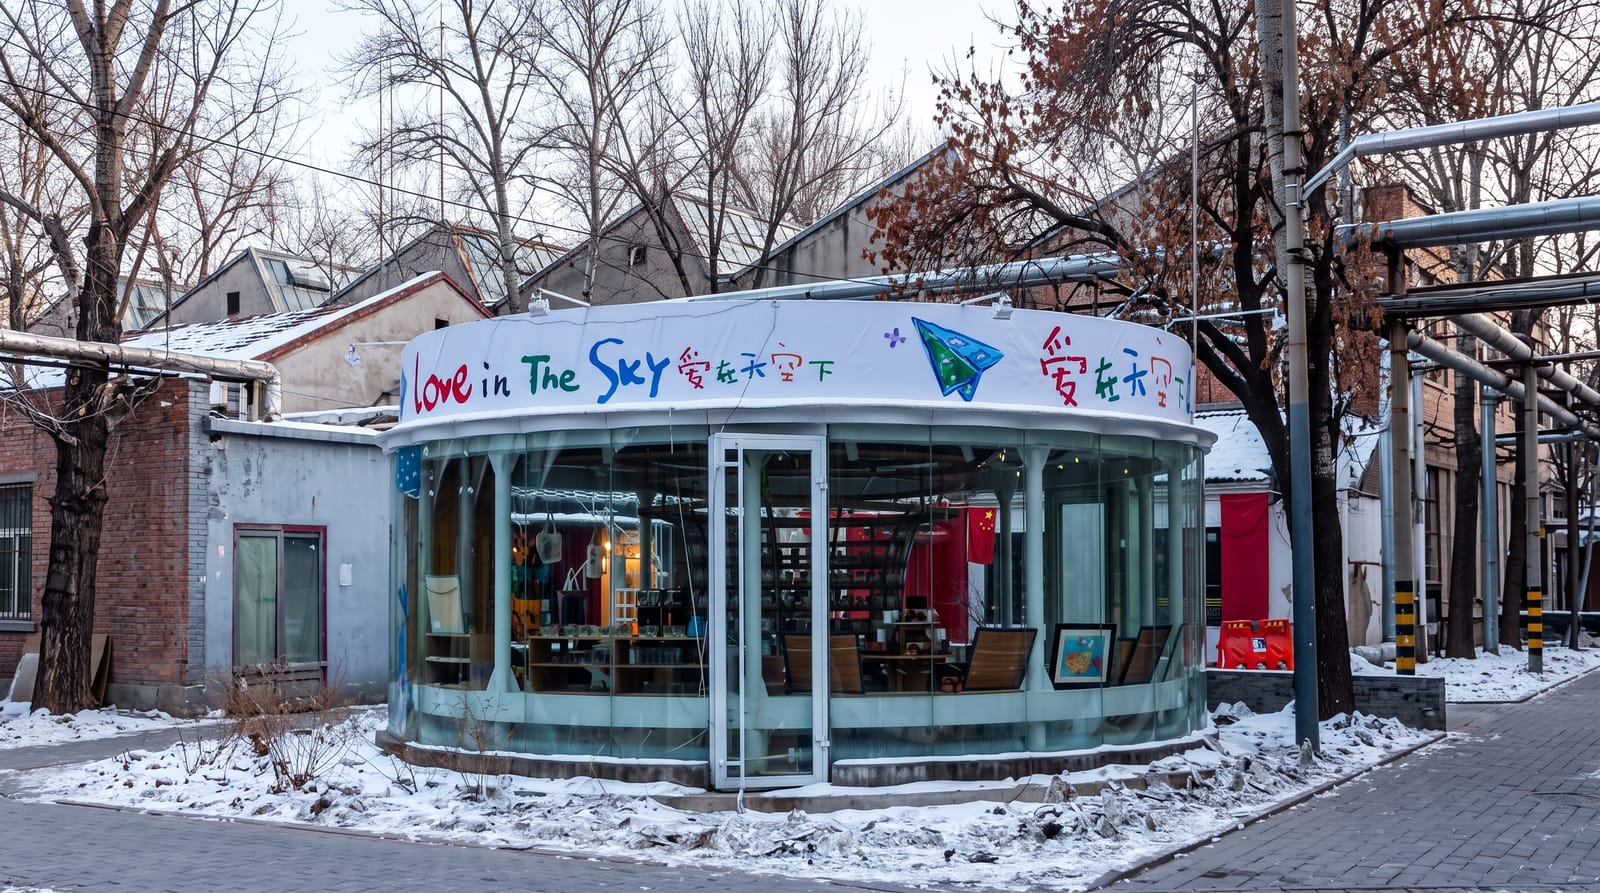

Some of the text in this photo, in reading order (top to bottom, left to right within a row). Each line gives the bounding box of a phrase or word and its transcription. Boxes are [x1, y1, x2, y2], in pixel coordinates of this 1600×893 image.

[481, 361, 511, 398] in
[520, 354, 581, 396] The
[677, 342, 835, 389] 爱在天空下
[1039, 326, 1185, 408] 爱在天空下
